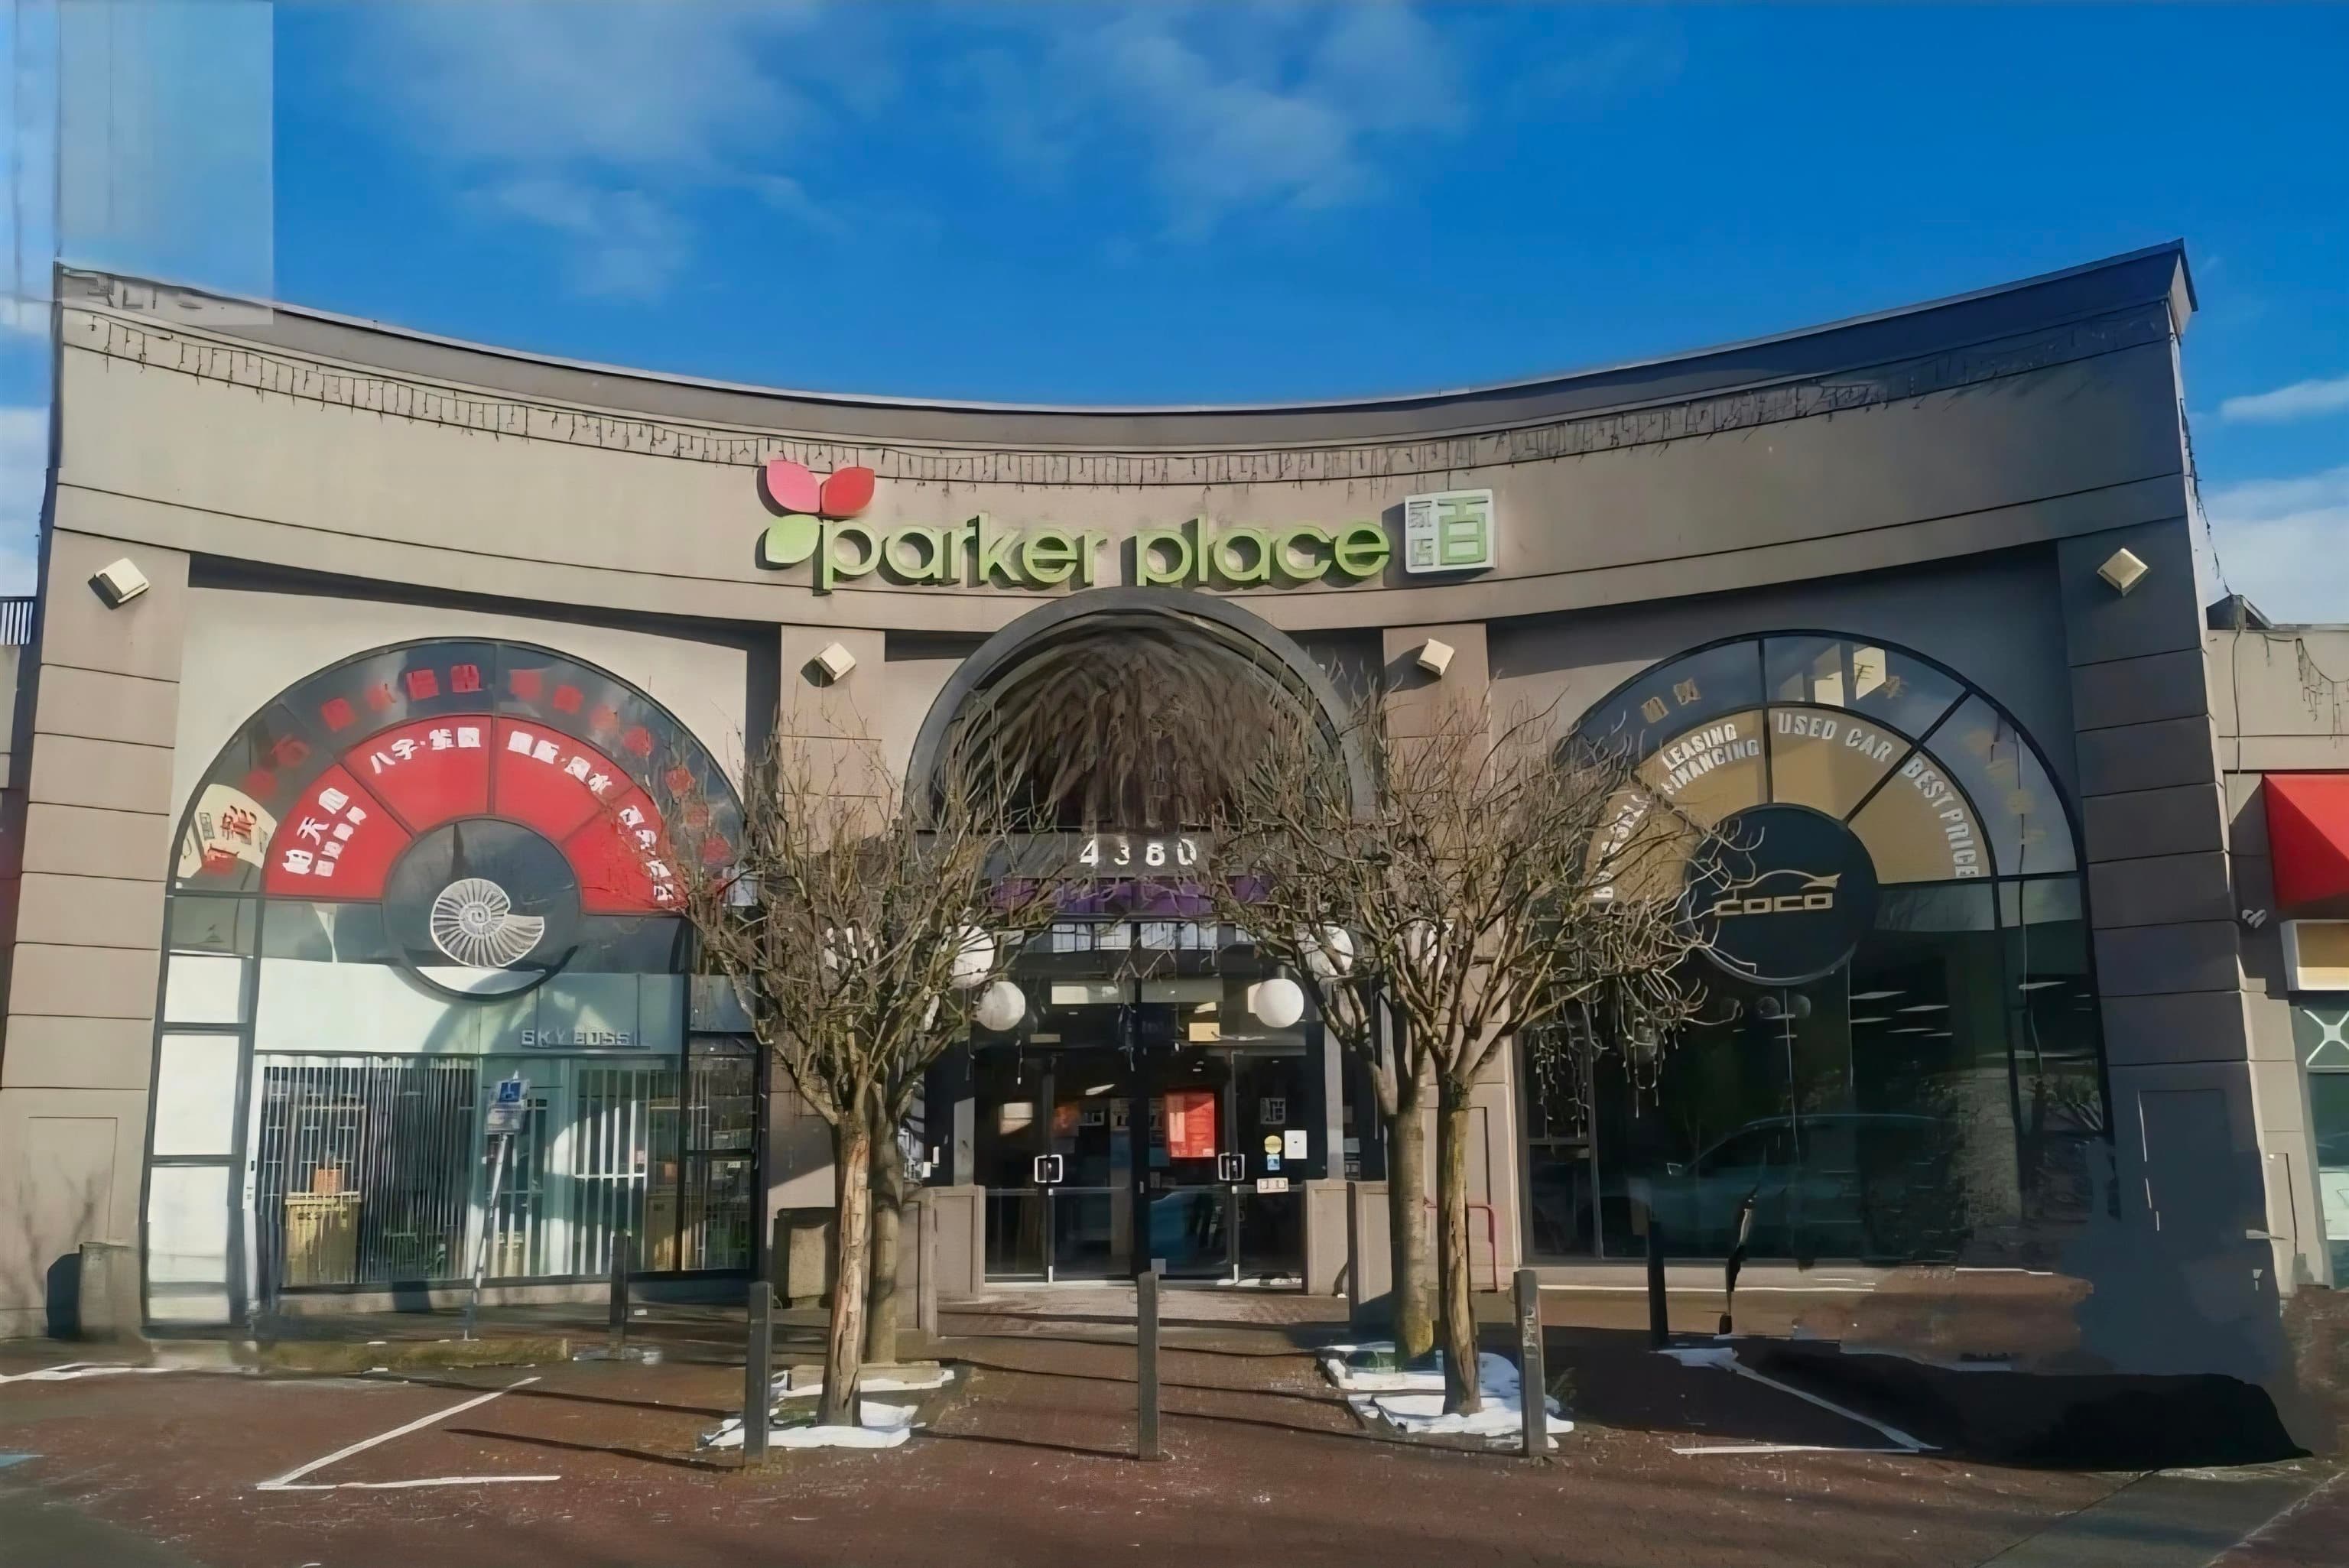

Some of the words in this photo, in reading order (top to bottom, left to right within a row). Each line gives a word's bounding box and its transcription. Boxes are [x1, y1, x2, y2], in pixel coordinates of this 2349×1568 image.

[823, 511, 1108, 589] parker
[1136, 512, 1390, 586] place
[1778, 712, 1838, 741] USED
[1845, 728, 1893, 762] CAR
